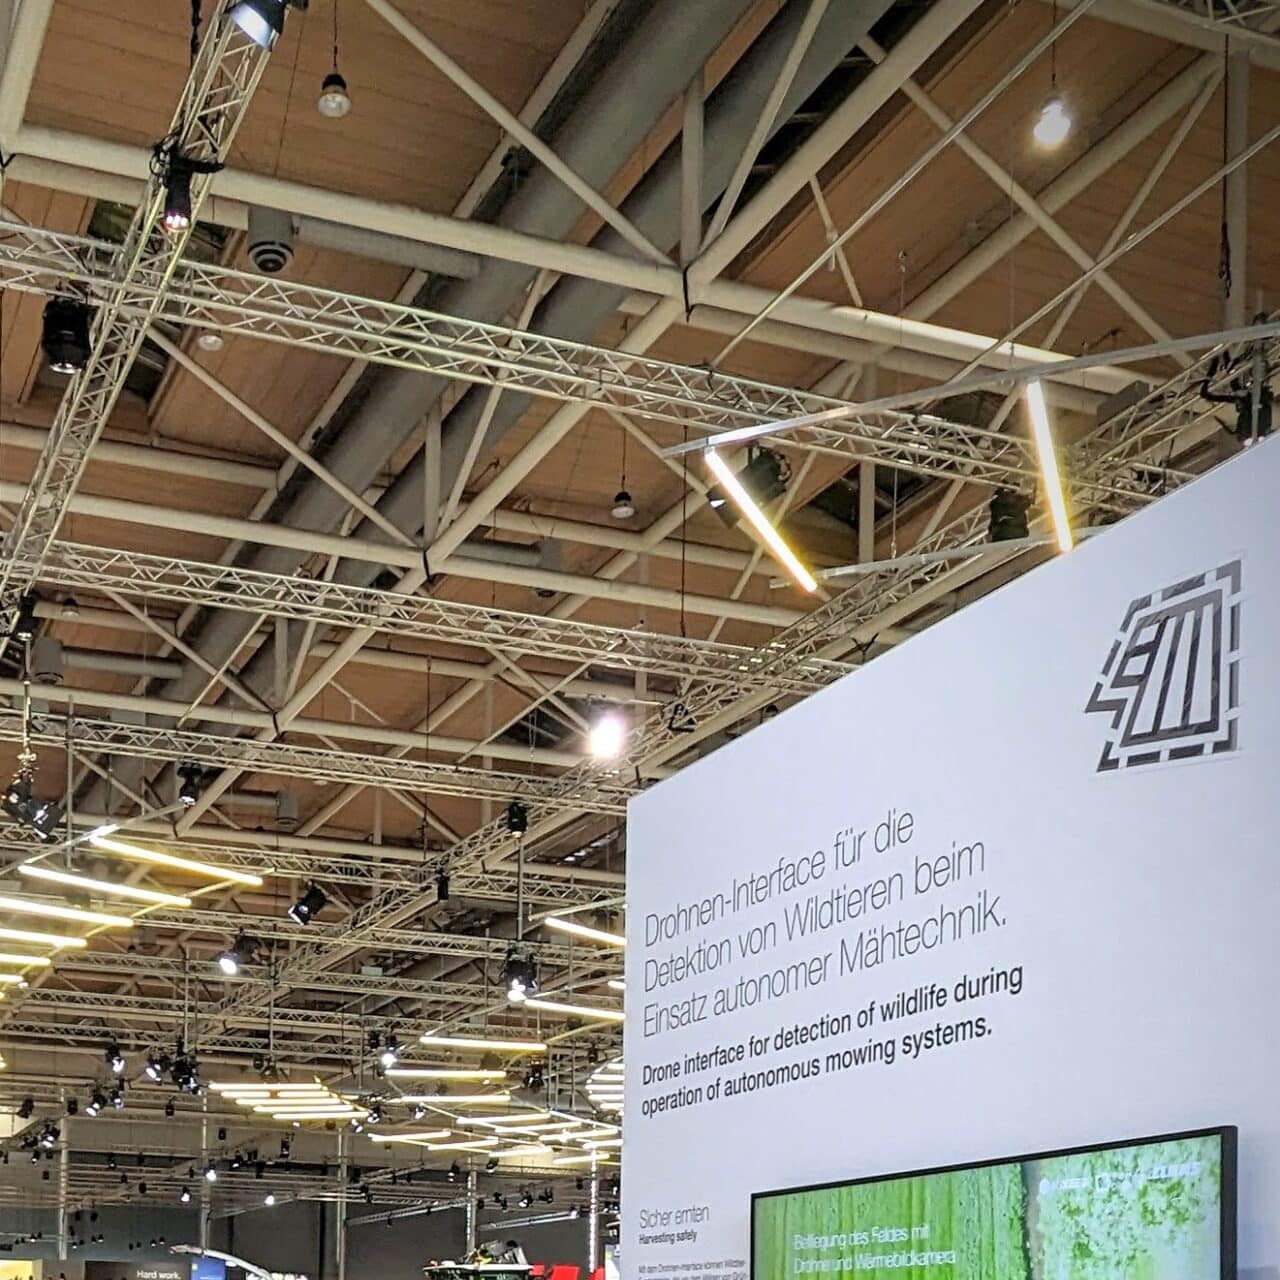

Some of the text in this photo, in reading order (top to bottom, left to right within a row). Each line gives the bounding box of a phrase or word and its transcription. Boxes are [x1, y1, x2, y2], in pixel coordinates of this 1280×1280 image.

[645, 842, 984, 992] Detektion von Wildtieren beim
[646, 809, 913, 947] Drohnen-Interface für die
[643, 966, 1022, 1085] Drone interface for detection of wildlife during
[644, 890, 1006, 1037] Einsatz autonomer Mähtechnik.
[642, 1018, 991, 1118] operation of autonomous mowing systems.
[136, 1270, 181, 1280] Hard work.
